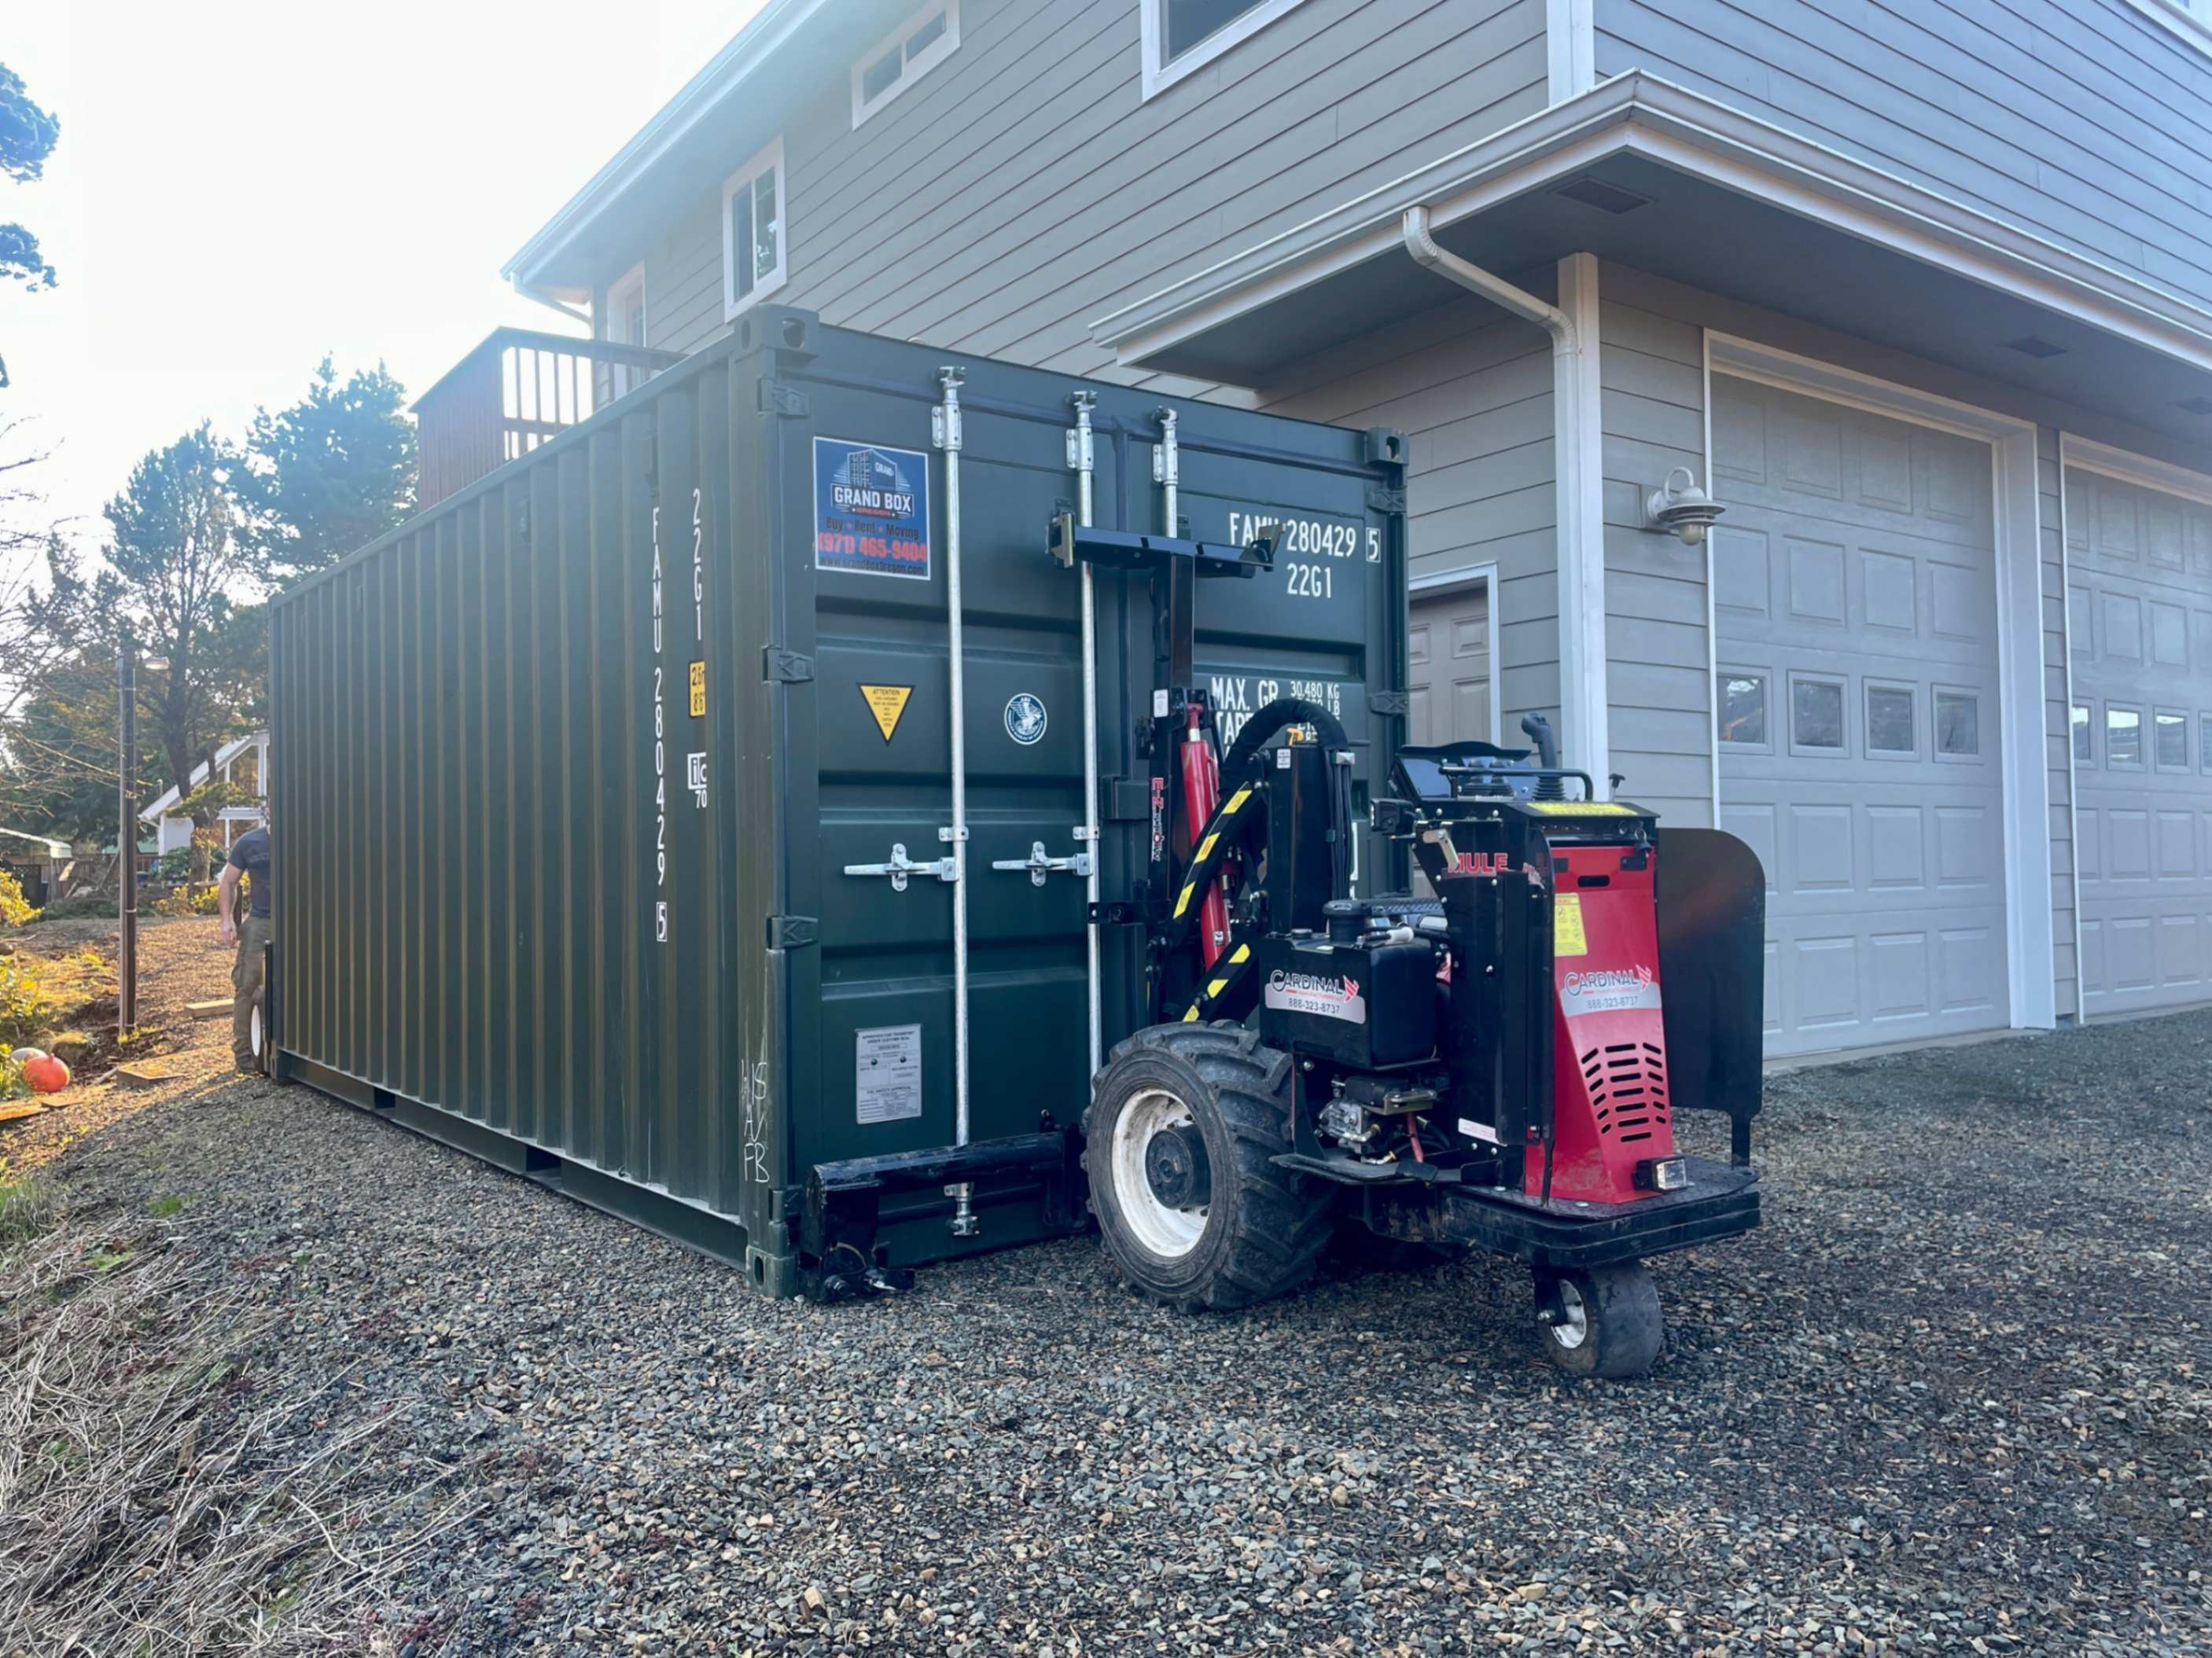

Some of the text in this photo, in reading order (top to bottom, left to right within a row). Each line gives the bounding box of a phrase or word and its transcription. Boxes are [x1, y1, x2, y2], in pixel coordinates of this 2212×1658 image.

[834, 487, 911, 513] GRAND BOX
[826, 517, 919, 540] Buy Rent Moving
[1286, 519, 1356, 557] 280429
[1367, 530, 1379, 561] 5
[693, 488, 702, 641] 22G1
[1286, 563, 1332, 598] 22G1
[1211, 677, 1250, 711] MAX.
[1258, 679, 1279, 708] GR
[1327, 682, 1340, 700] KG
[1327, 700, 1340, 715] LB
[653, 507, 666, 941] FAMU 280429 5
[694, 789, 708, 809] 70
[1270, 969, 1343, 994] CARDINAL
[1565, 969, 1640, 997] CARDINAL
[1288, 998, 1340, 1014] 888-323-8737
